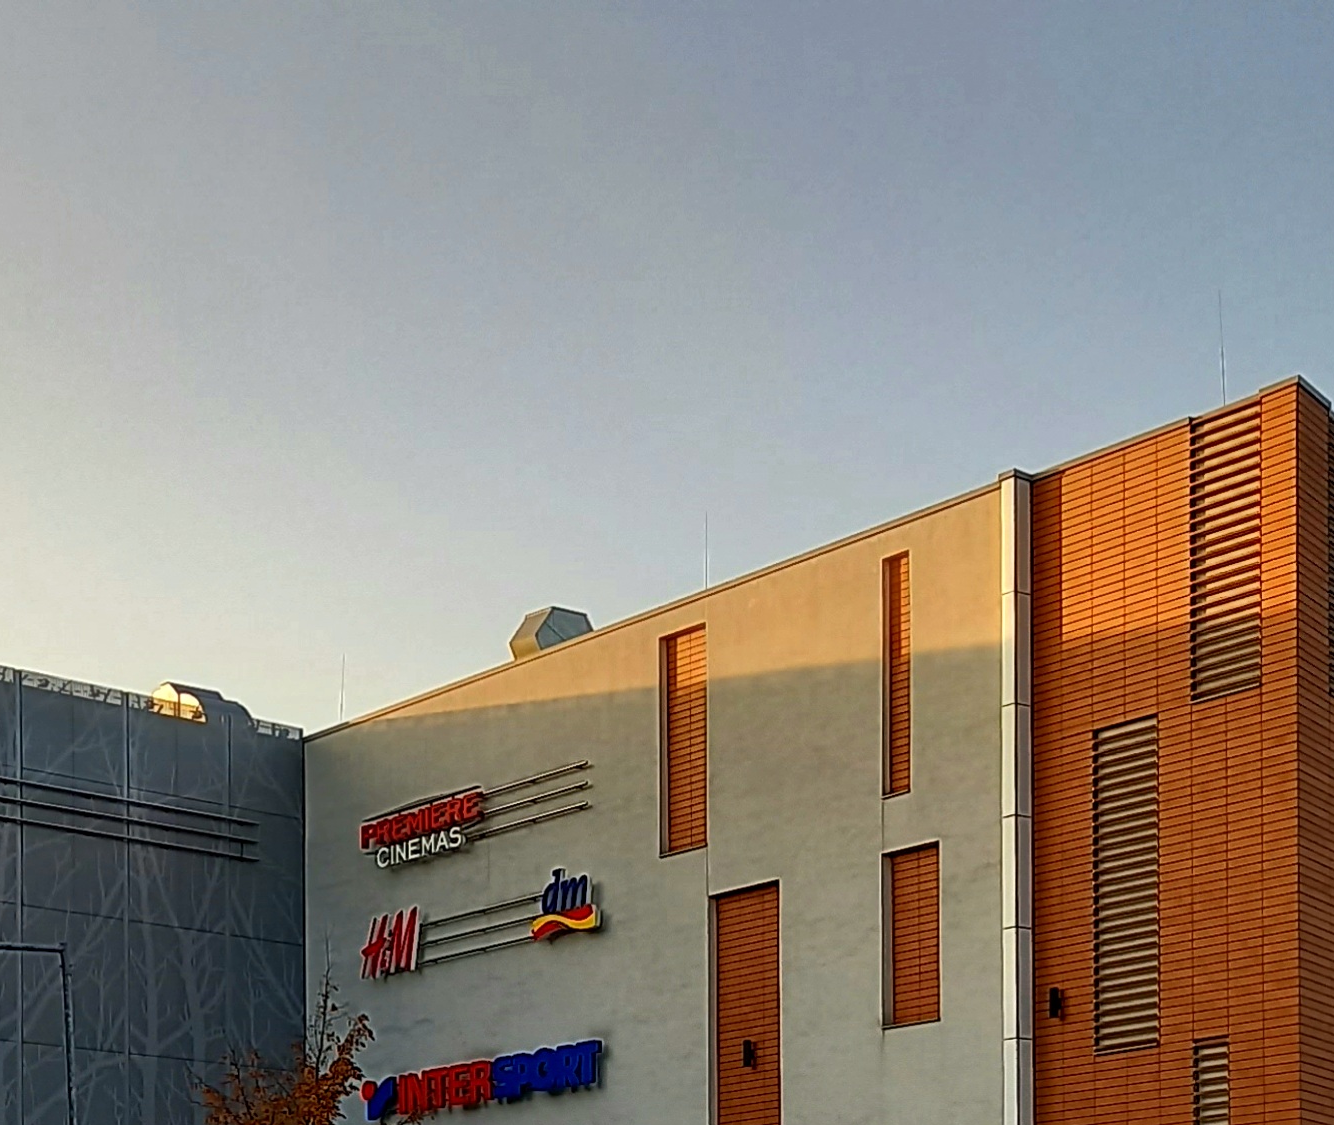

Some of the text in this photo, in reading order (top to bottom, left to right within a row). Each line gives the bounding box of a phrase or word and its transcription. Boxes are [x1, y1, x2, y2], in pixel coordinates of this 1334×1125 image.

[360, 790, 484, 850] PREMIERE
[376, 826, 463, 868] CINEMAS
[541, 867, 594, 915] dm
[360, 906, 419, 980] H&M
[398, 1040, 603, 1116] INTERSPORT
